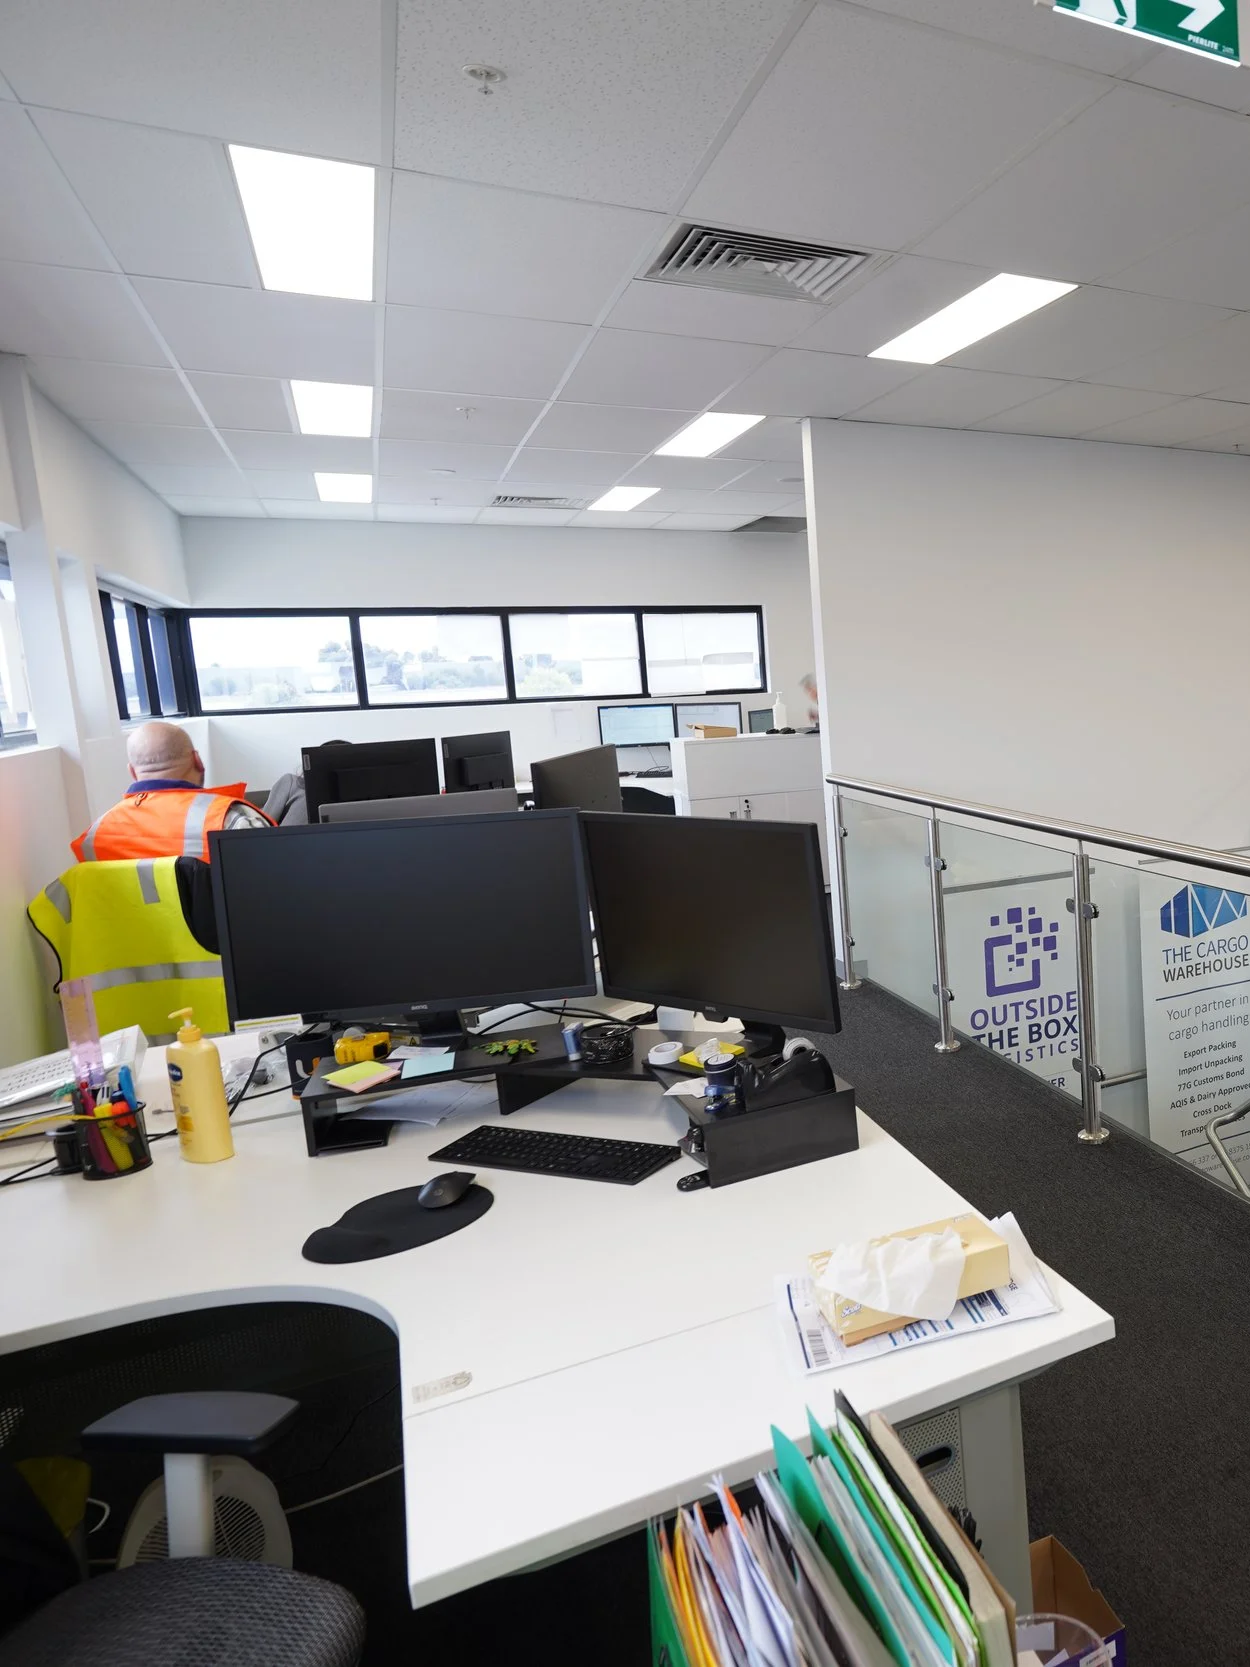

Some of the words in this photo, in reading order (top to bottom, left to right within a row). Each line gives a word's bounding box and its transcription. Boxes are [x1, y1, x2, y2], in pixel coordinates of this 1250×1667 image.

[1162, 945, 1193, 965] THE
[1196, 935, 1249, 958] CARGO
[1163, 954, 1250, 982] WAREHOUSE
[970, 990, 1077, 1031] OUTSIDE
[1167, 1006, 1192, 1021] Your
[1194, 996, 1236, 1017] partner
[1239, 994, 1249, 1005] in
[1028, 1014, 1078, 1044] BOX
[1168, 1025, 1199, 1041] cargo
[1201, 1014, 1250, 1033] handling
[1003, 1038, 1079, 1064] ISTICS
[1183, 1046, 1207, 1059] Export
[1208, 1040, 1237, 1052] Packing
[1178, 1063, 1203, 1077] Import
[1204, 1054, 1243, 1069] Unpacking
[1177, 1081, 1192, 1092] 77G
[1193, 1073, 1224, 1087] Customs
[1225, 1067, 1245, 1079] Bond
[1170, 1098, 1188, 1110] AQIS
[1189, 1095, 1196, 1104] &
[1197, 1090, 1217, 1102] Dairy
[1192, 1107, 1212, 1119] Cross
[1213, 1101, 1232, 1113] Dock
[1180, 1124, 1207, 1138] Transp
